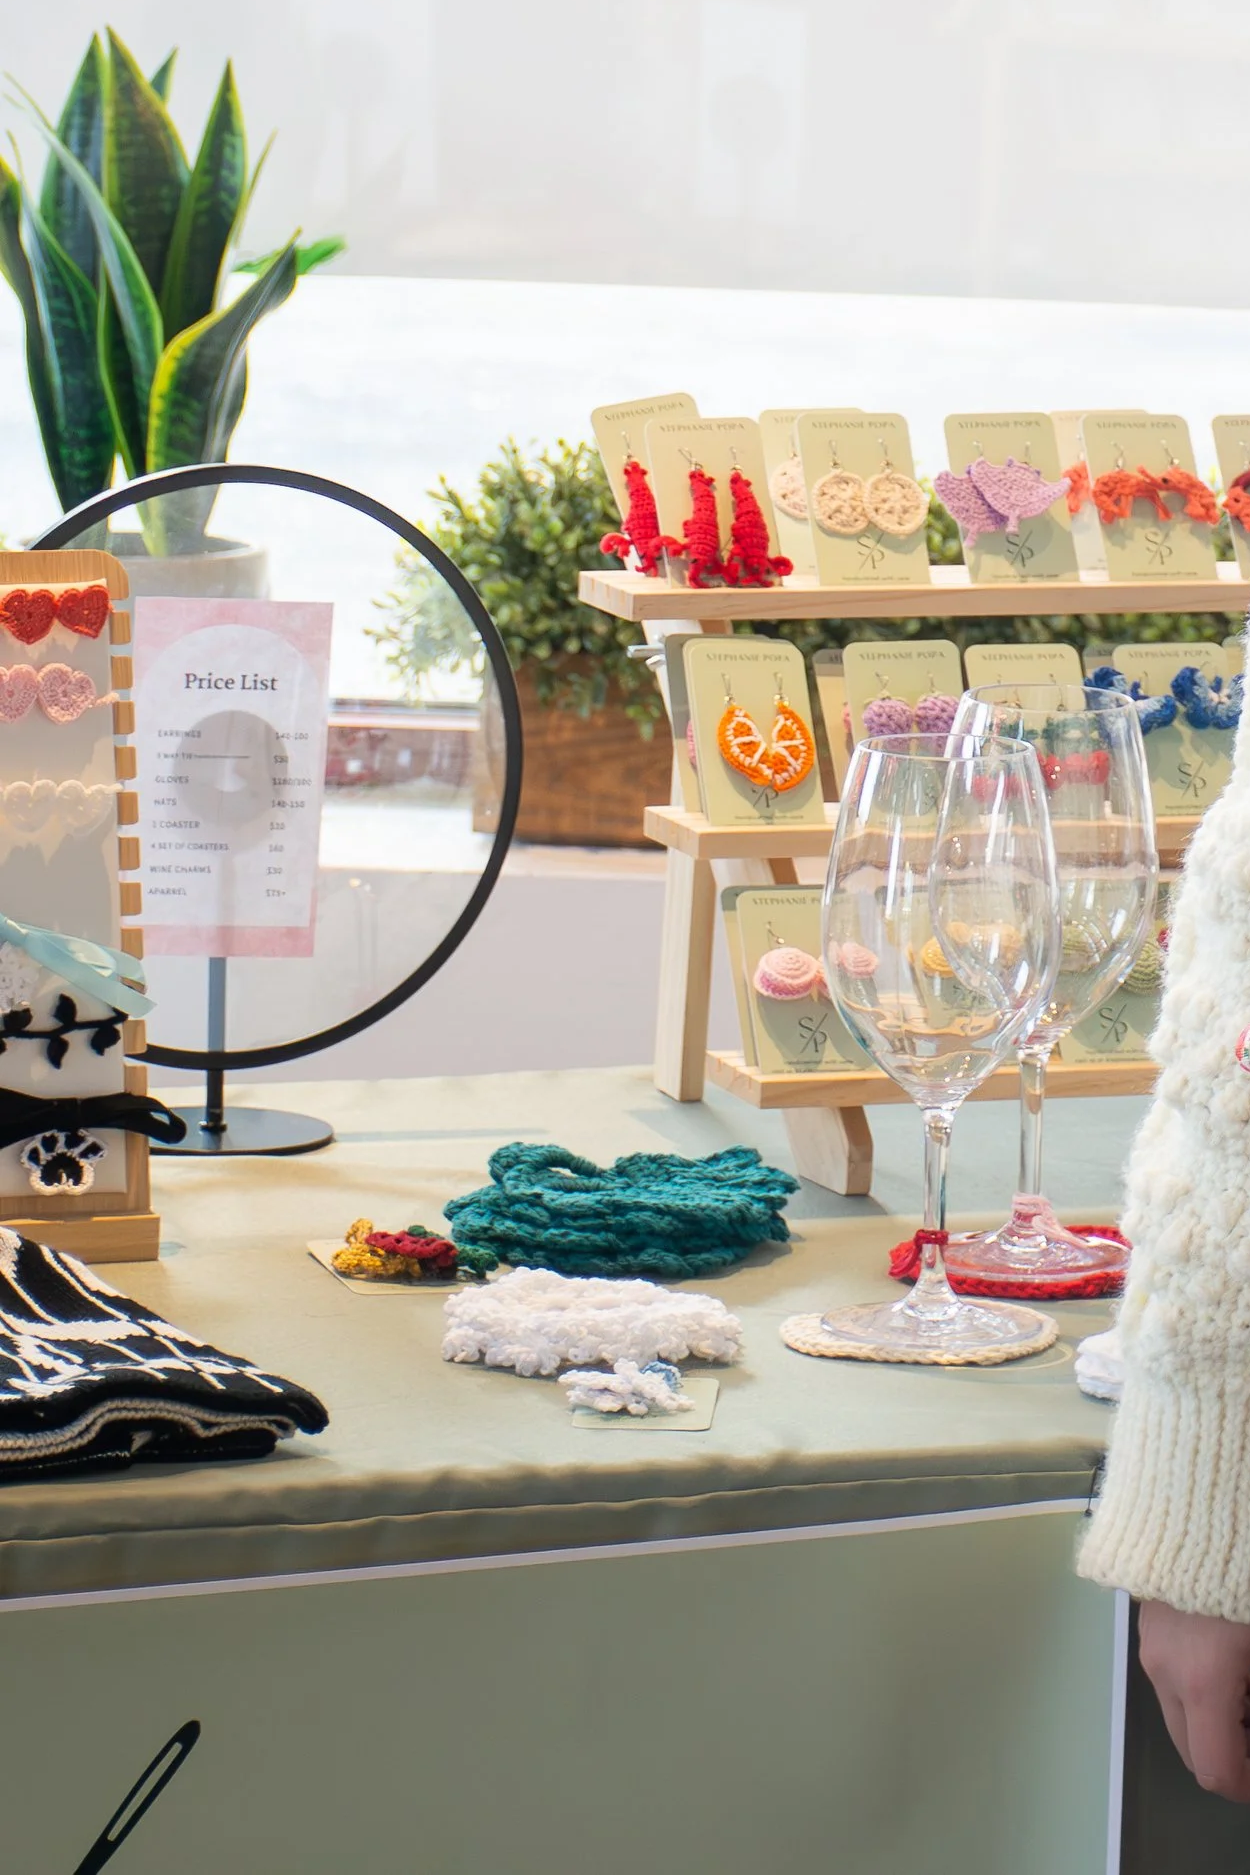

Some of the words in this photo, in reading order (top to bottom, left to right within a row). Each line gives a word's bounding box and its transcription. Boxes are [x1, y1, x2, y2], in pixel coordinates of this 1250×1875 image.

[184, 672, 235, 691] Price
[241, 673, 279, 691] List
[155, 775, 189, 785] GLOVES
[154, 797, 177, 807] HATS
[159, 820, 201, 829] COASTER
[175, 842, 185, 850] OF
[187, 842, 230, 851] COASTERS
[150, 865, 172, 874] WINE
[174, 865, 212, 875] CHARMS
